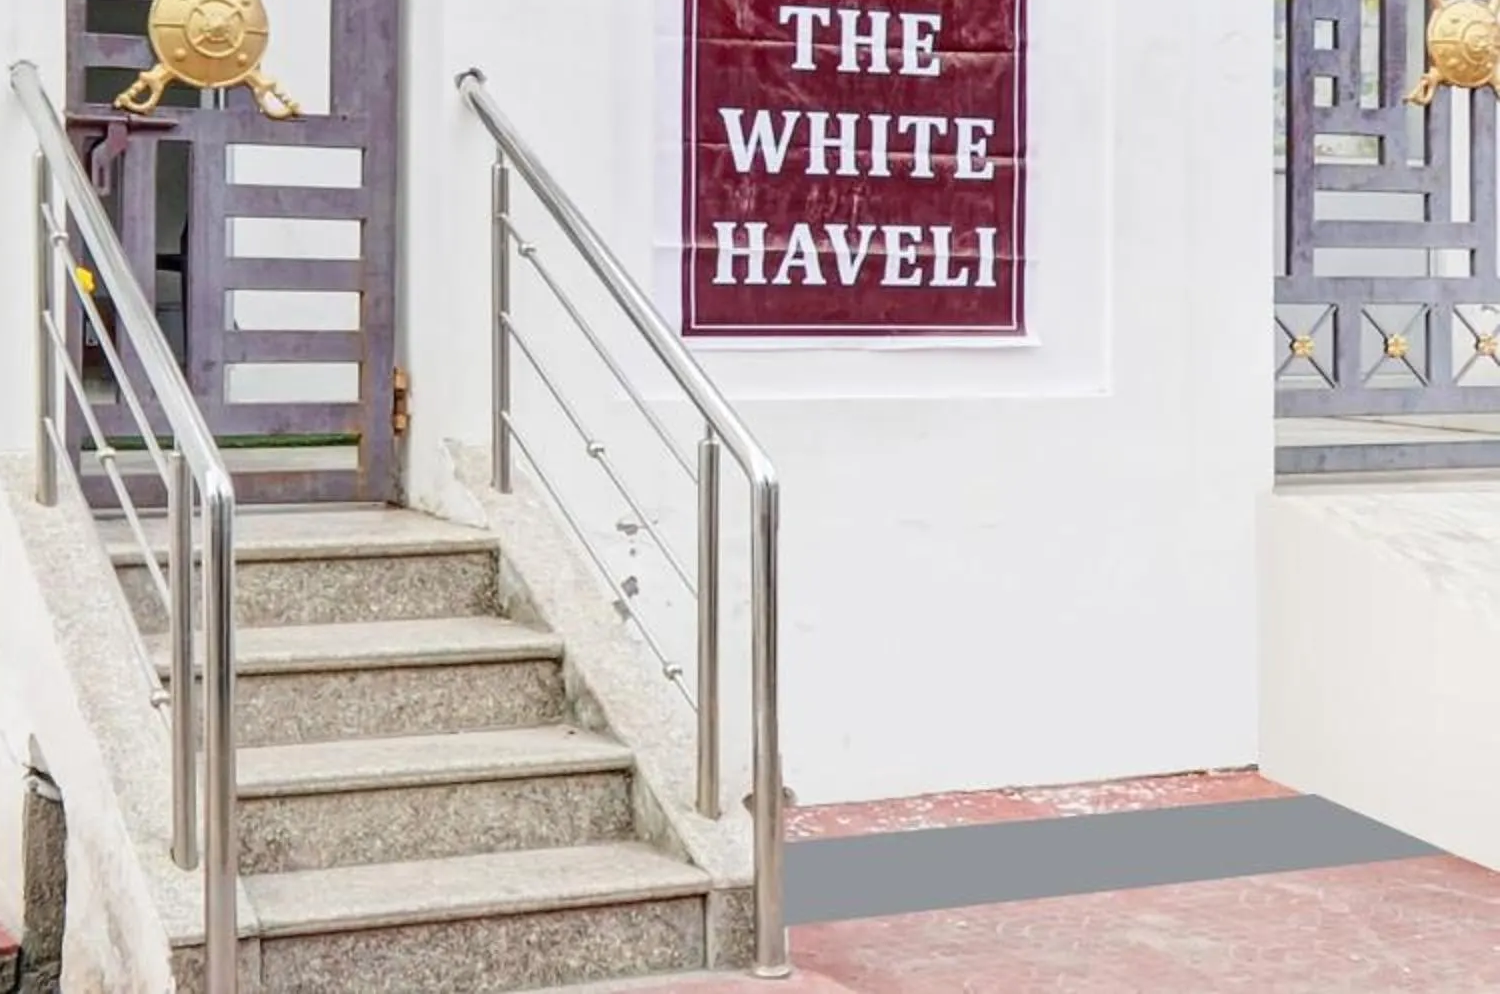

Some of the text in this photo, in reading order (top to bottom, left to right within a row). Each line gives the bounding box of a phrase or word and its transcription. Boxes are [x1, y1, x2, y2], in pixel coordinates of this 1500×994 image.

[779, 5, 942, 77] THE
[718, 107, 995, 180] WHITE
[712, 221, 997, 287] HAVELI
